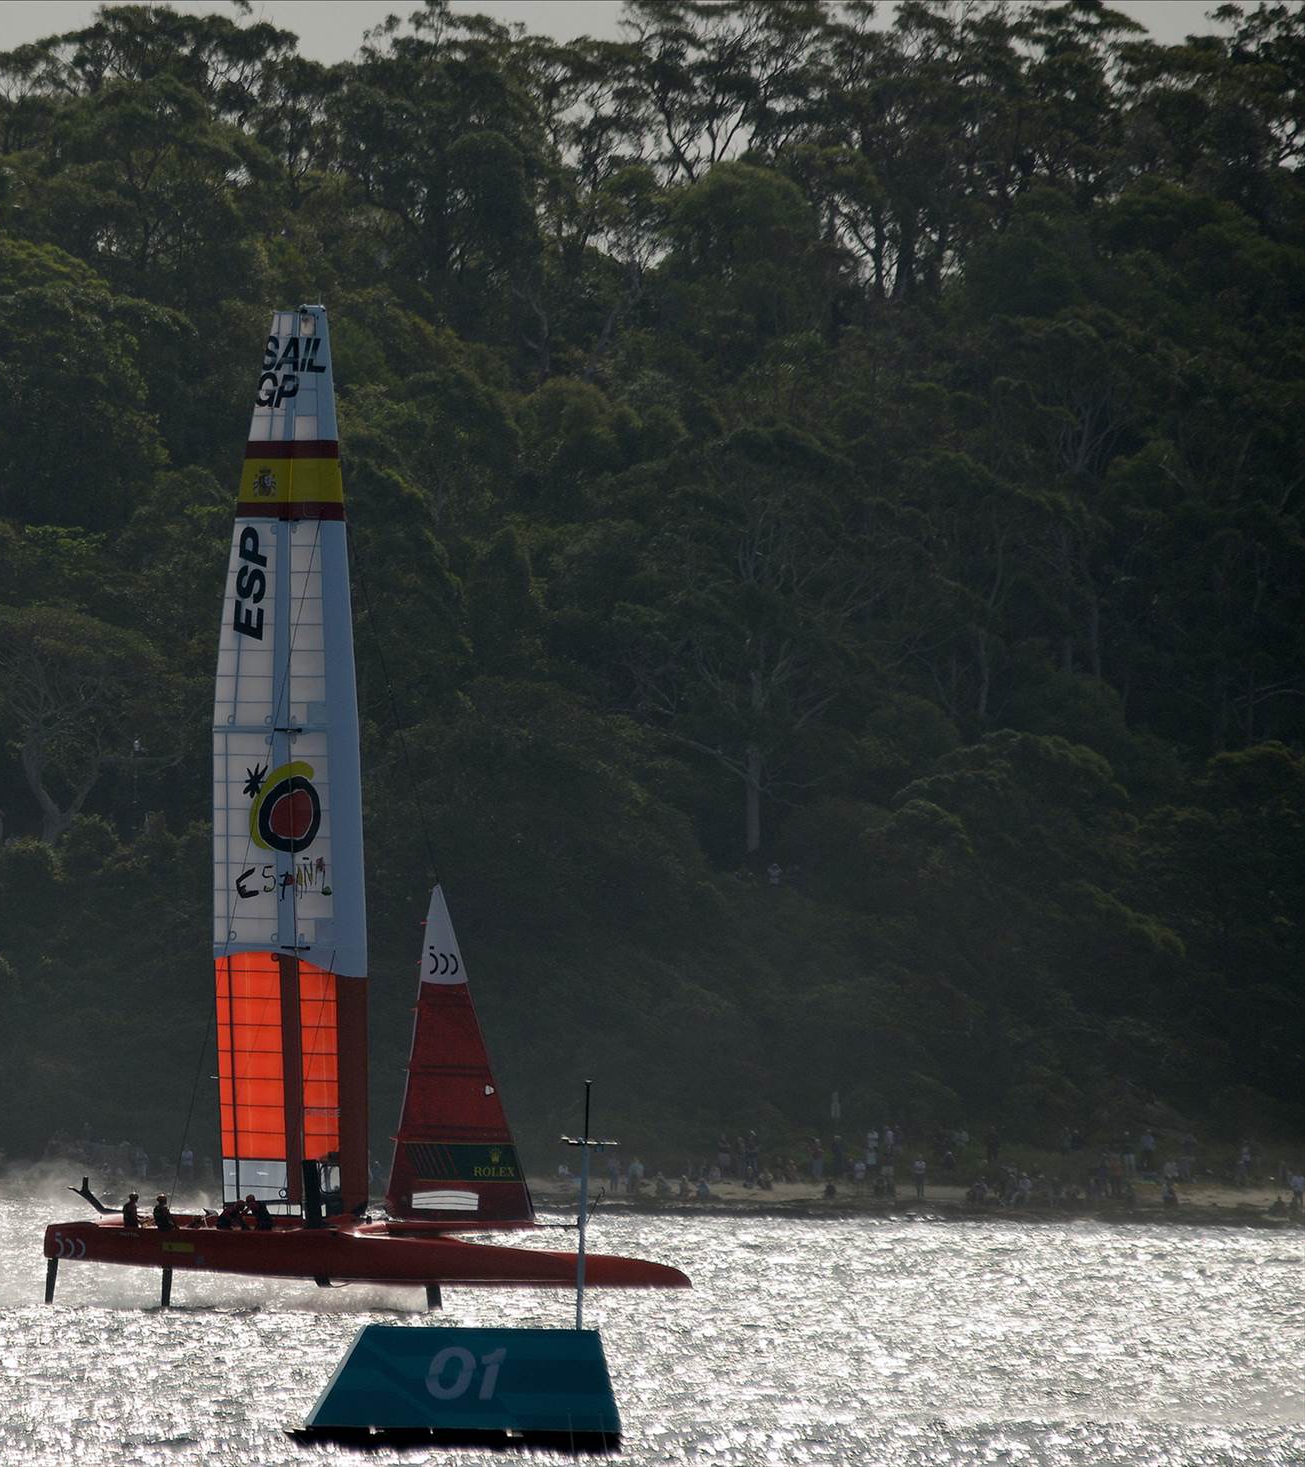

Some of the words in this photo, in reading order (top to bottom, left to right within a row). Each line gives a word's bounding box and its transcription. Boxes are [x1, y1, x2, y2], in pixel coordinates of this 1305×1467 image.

[261, 335, 327, 374] SAIL
[255, 372, 300, 409] GP
[233, 526, 268, 641] ESP
[473, 1165, 515, 1177] ROLEX
[425, 1346, 508, 1401] 01
